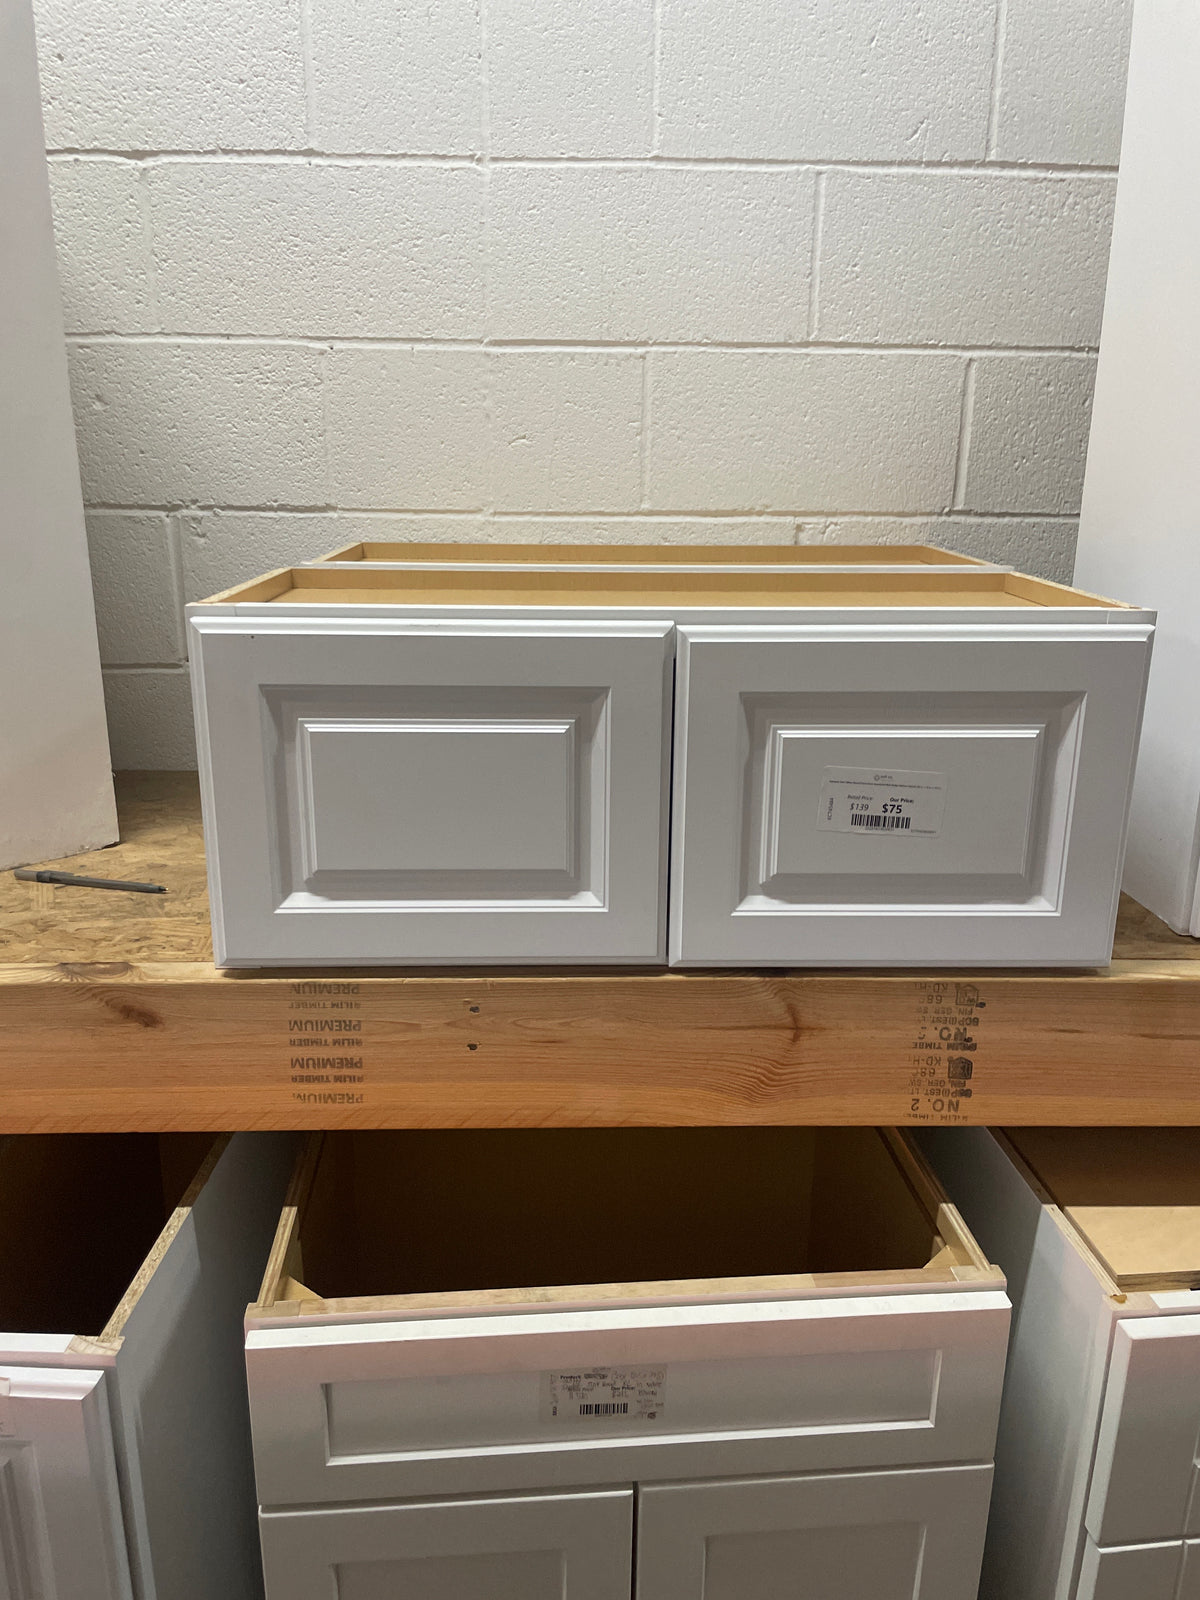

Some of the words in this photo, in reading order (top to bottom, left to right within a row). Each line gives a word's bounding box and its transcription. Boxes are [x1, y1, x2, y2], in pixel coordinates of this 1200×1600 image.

[850, 802, 869, 812] $139
[882, 803, 902, 814] $75
[288, 1019, 362, 1032] PREMIUM
[289, 1038, 330, 1047] TIMBER
[290, 1057, 363, 1070] PREMIUM
[291, 1074, 330, 1084] TIMBER
[910, 1098, 920, 1112] 2
[928, 1098, 960, 1113] NO.
